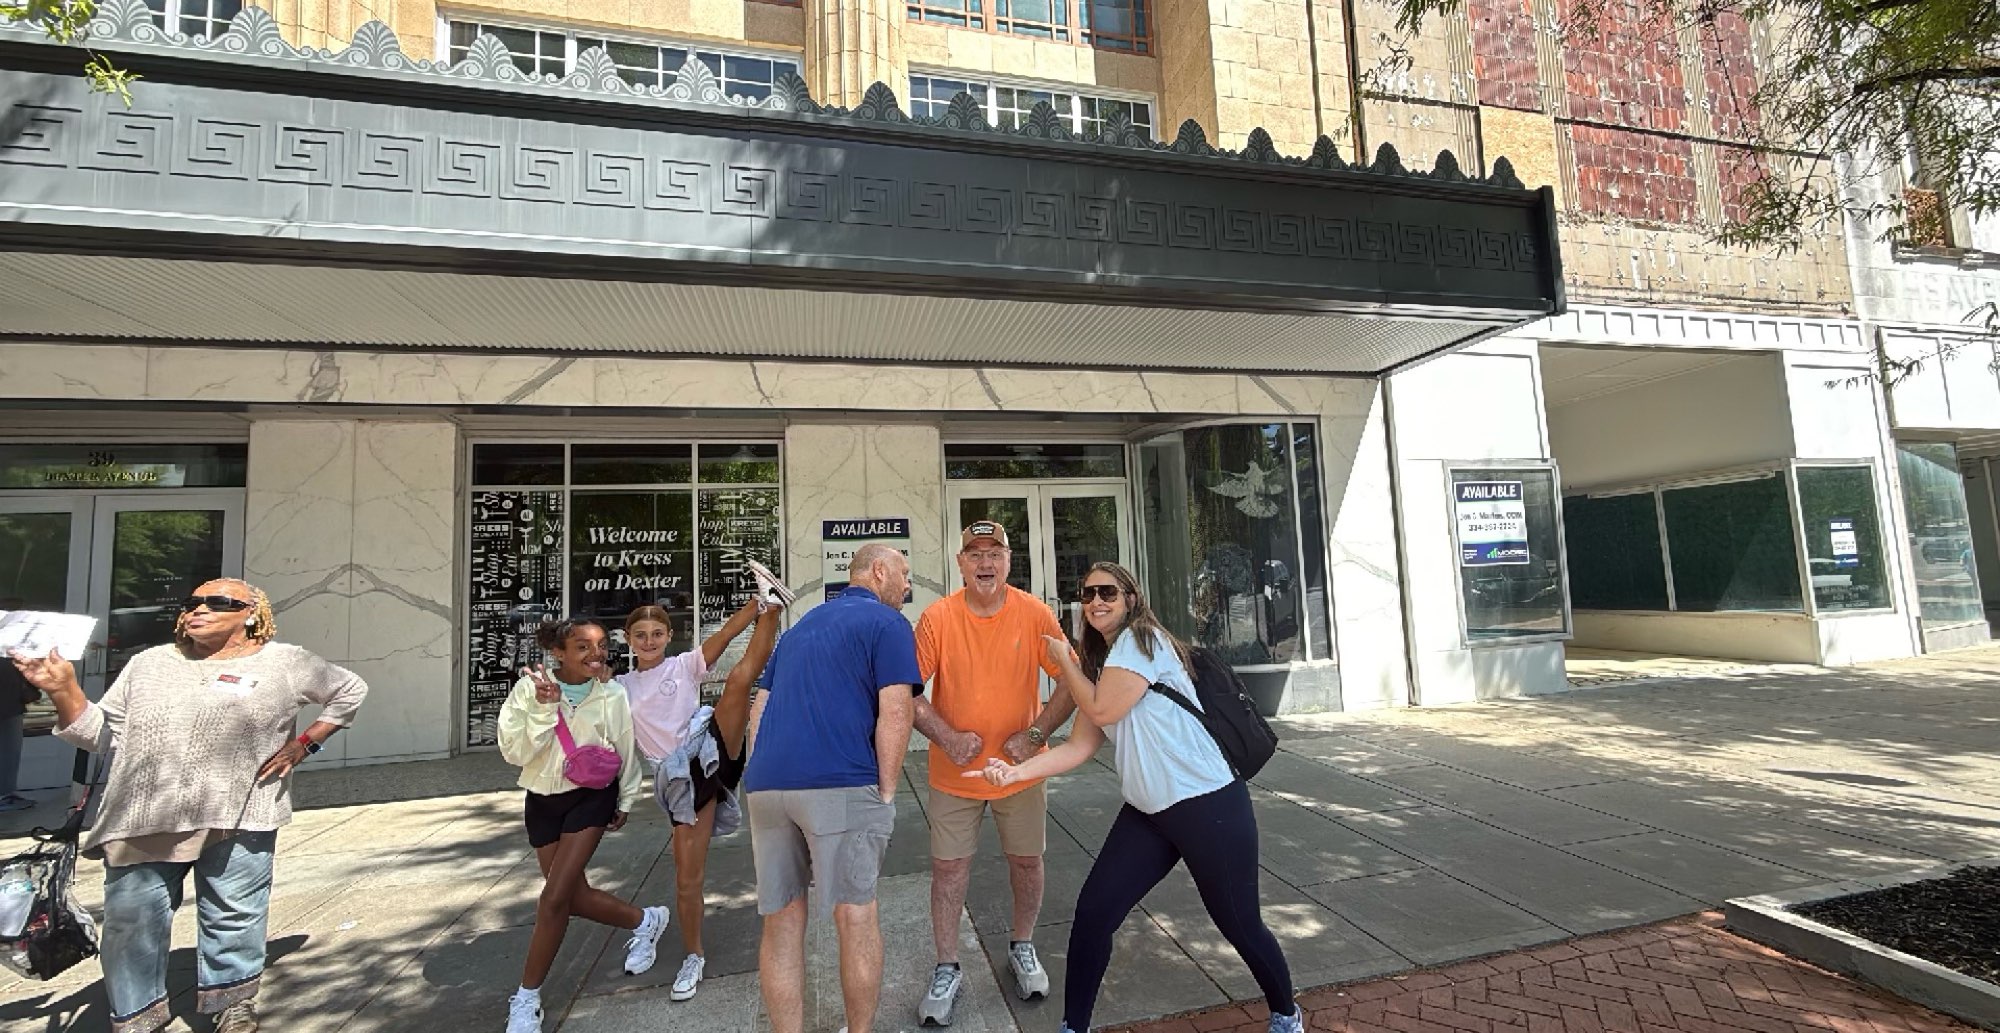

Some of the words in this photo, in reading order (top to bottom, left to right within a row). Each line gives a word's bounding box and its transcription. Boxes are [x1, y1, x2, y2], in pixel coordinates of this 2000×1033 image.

[1462, 485, 1517, 499] AVAILABLE
[589, 526, 678, 544] Welcome
[830, 522, 902, 536] AVAILABLE
[593, 552, 614, 567] to
[618, 549, 672, 568] Kress
[719, 538, 744, 574] LIVE
[842, 551, 850, 559] C.
[584, 578, 610, 592] on
[614, 574, 682, 591] Dexter
